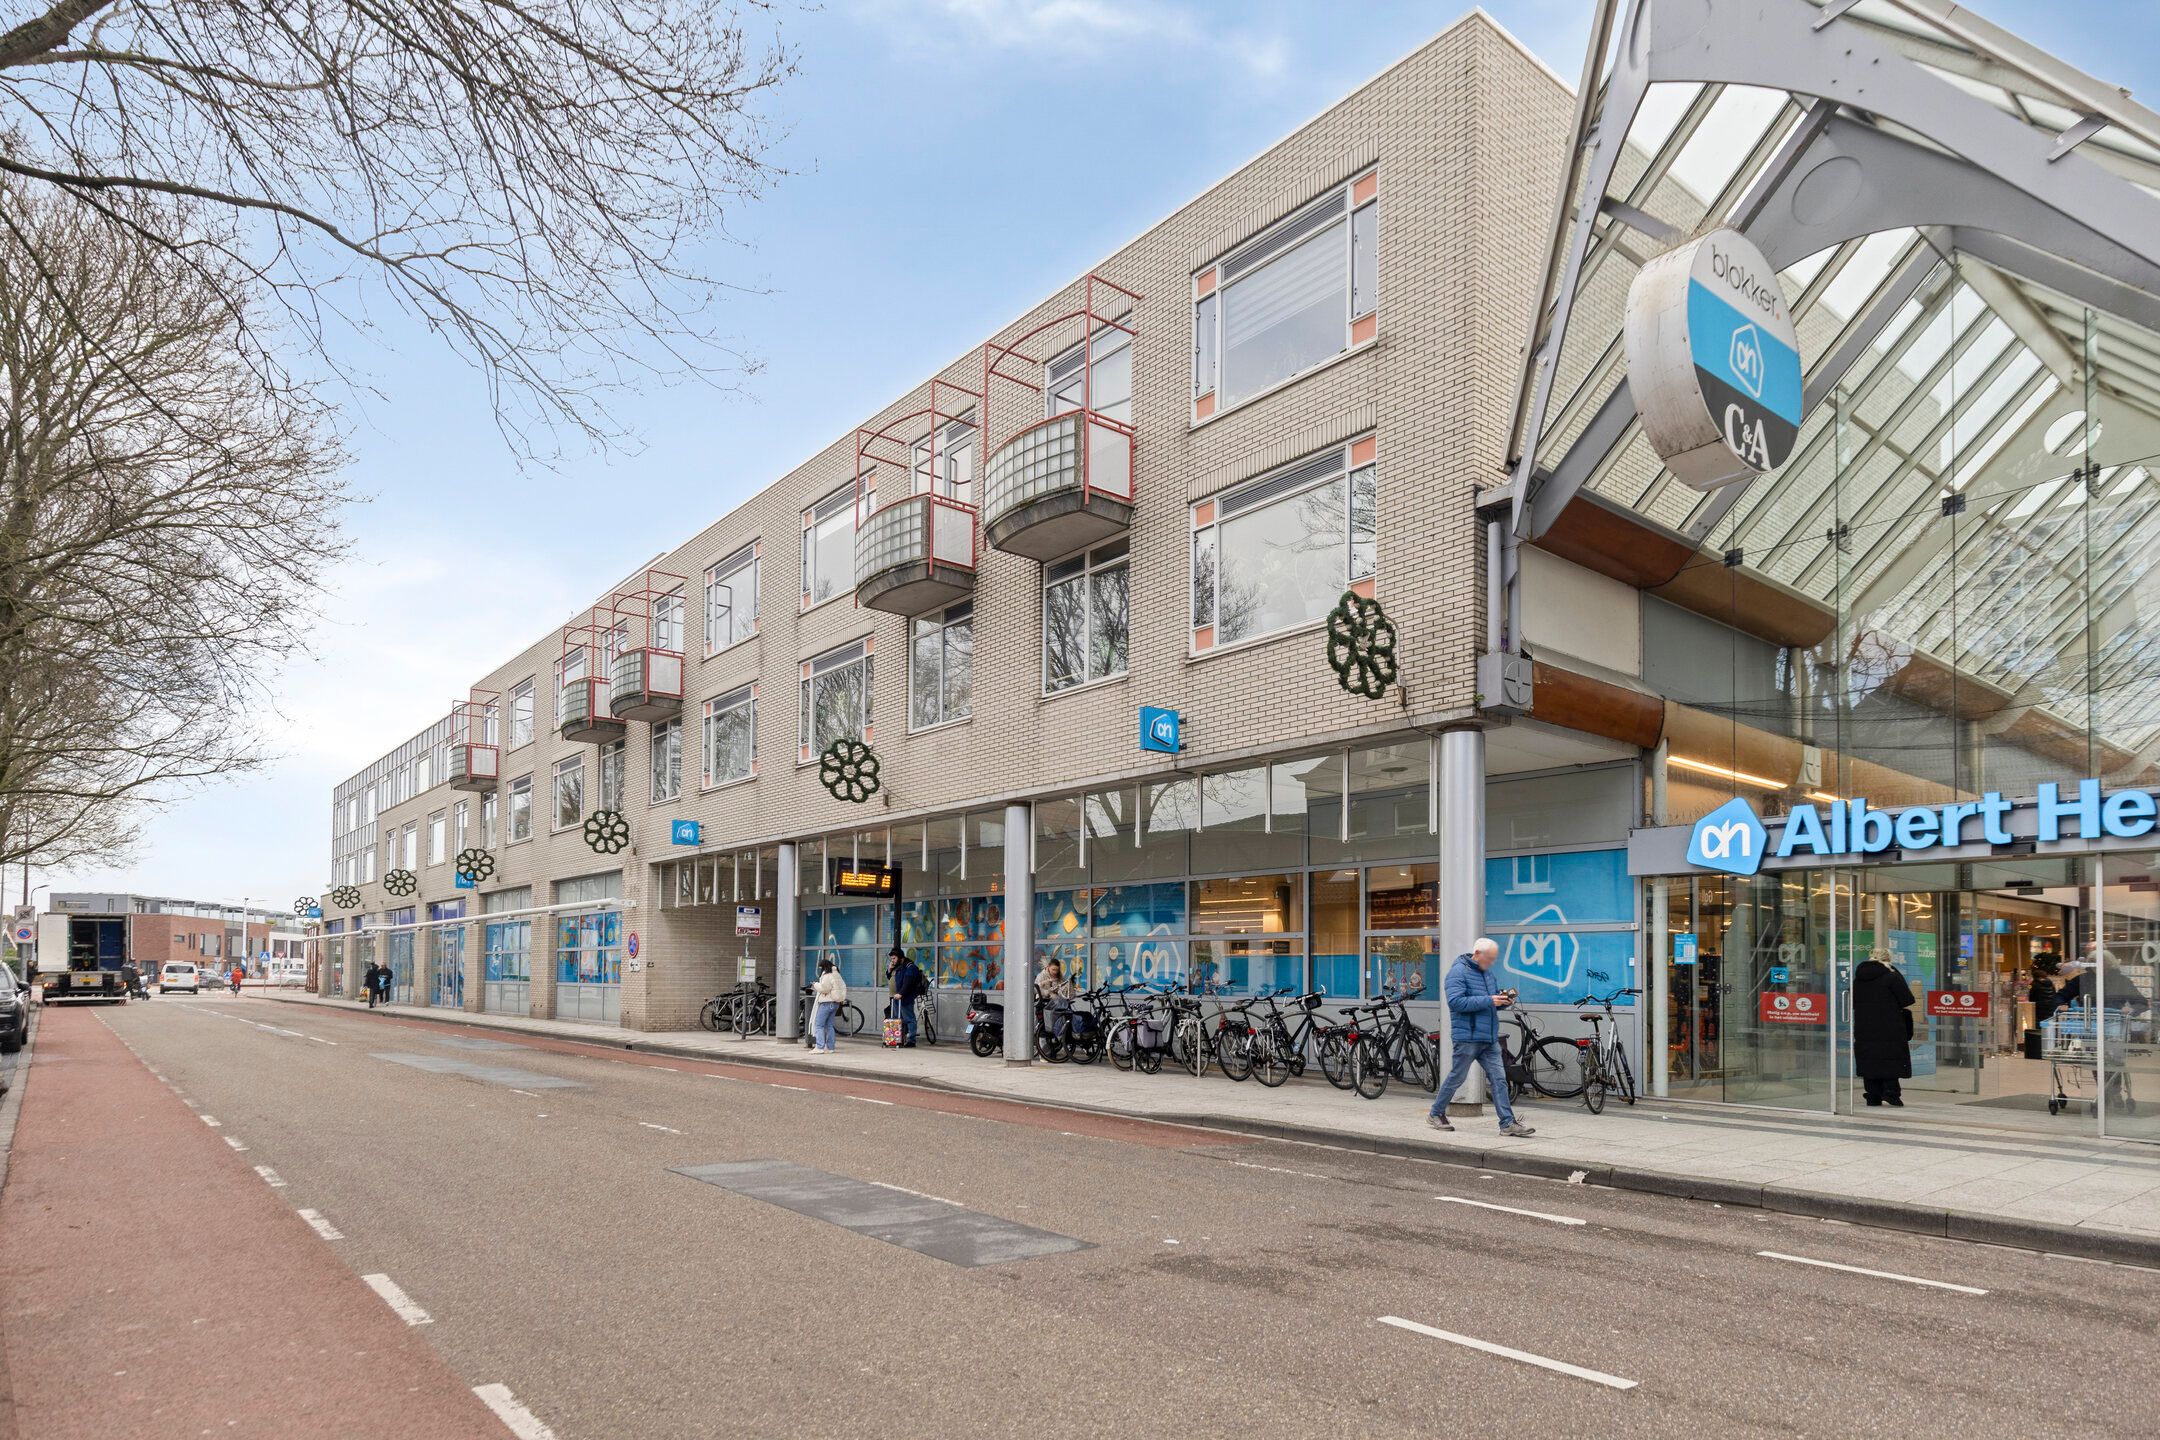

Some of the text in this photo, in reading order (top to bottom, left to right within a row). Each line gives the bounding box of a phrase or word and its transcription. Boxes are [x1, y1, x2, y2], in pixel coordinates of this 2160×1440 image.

[1724, 403, 1773, 472] C&A
[1776, 778, 2158, 857] Albert He
